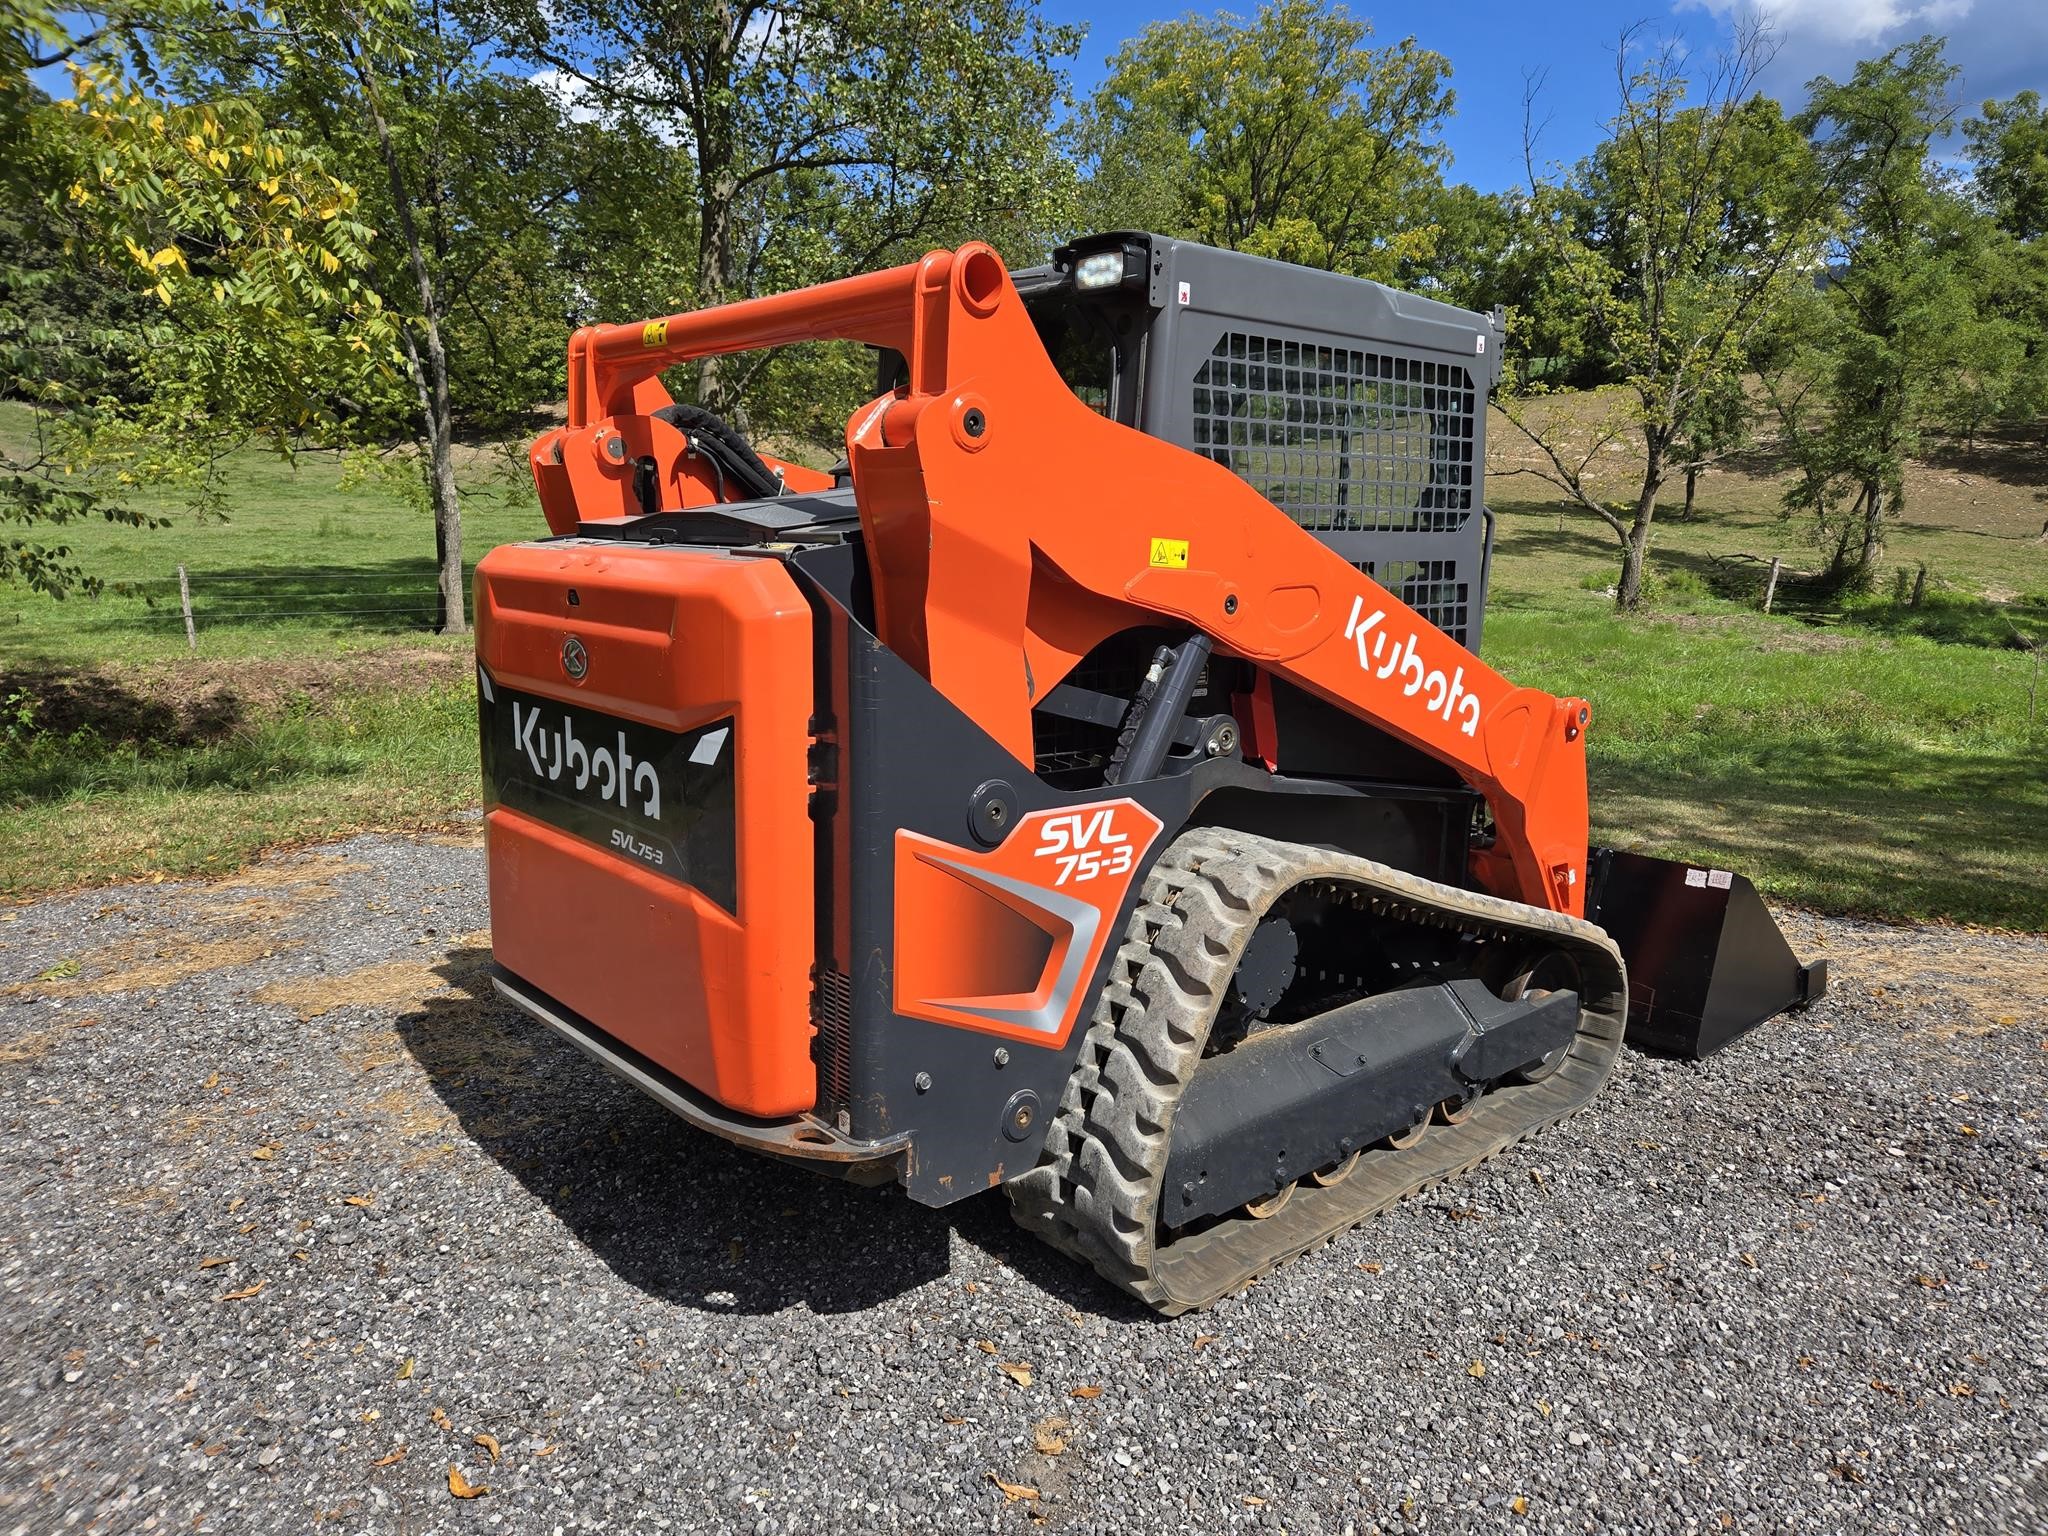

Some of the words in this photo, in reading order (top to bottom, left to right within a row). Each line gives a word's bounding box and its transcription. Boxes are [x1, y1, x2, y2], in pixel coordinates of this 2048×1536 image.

[1344, 594, 1480, 737] Kubota
[513, 701, 661, 821] Kubota
[1034, 809, 1128, 857] SVL
[1054, 845, 1134, 886] 75-3
